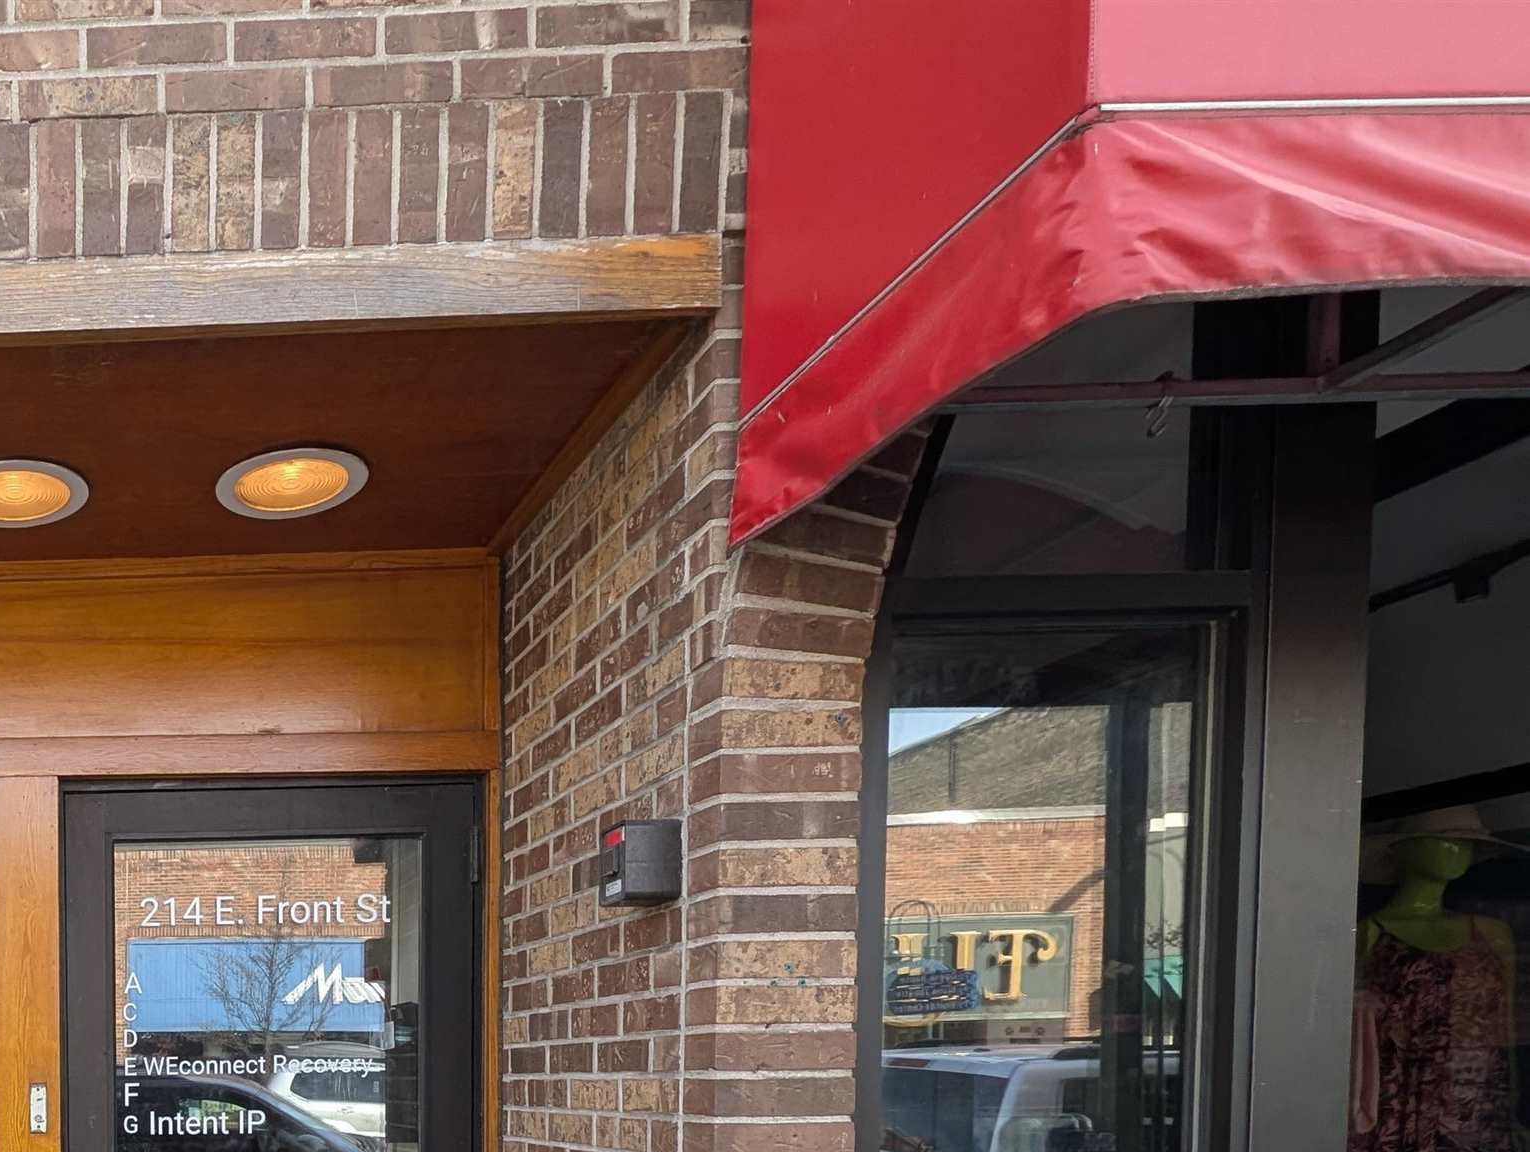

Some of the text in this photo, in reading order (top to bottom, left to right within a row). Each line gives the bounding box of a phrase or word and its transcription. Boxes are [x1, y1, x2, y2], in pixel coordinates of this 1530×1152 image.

[140, 893, 391, 928] 214 E. Front St
[124, 971, 143, 995] A
[123, 1003, 138, 1022] C
[123, 1029, 138, 1048] D
[123, 1053, 374, 1078] E WEconnect Recovery
[123, 1082, 141, 1108] F
[123, 1109, 267, 1136] G Intent IP
